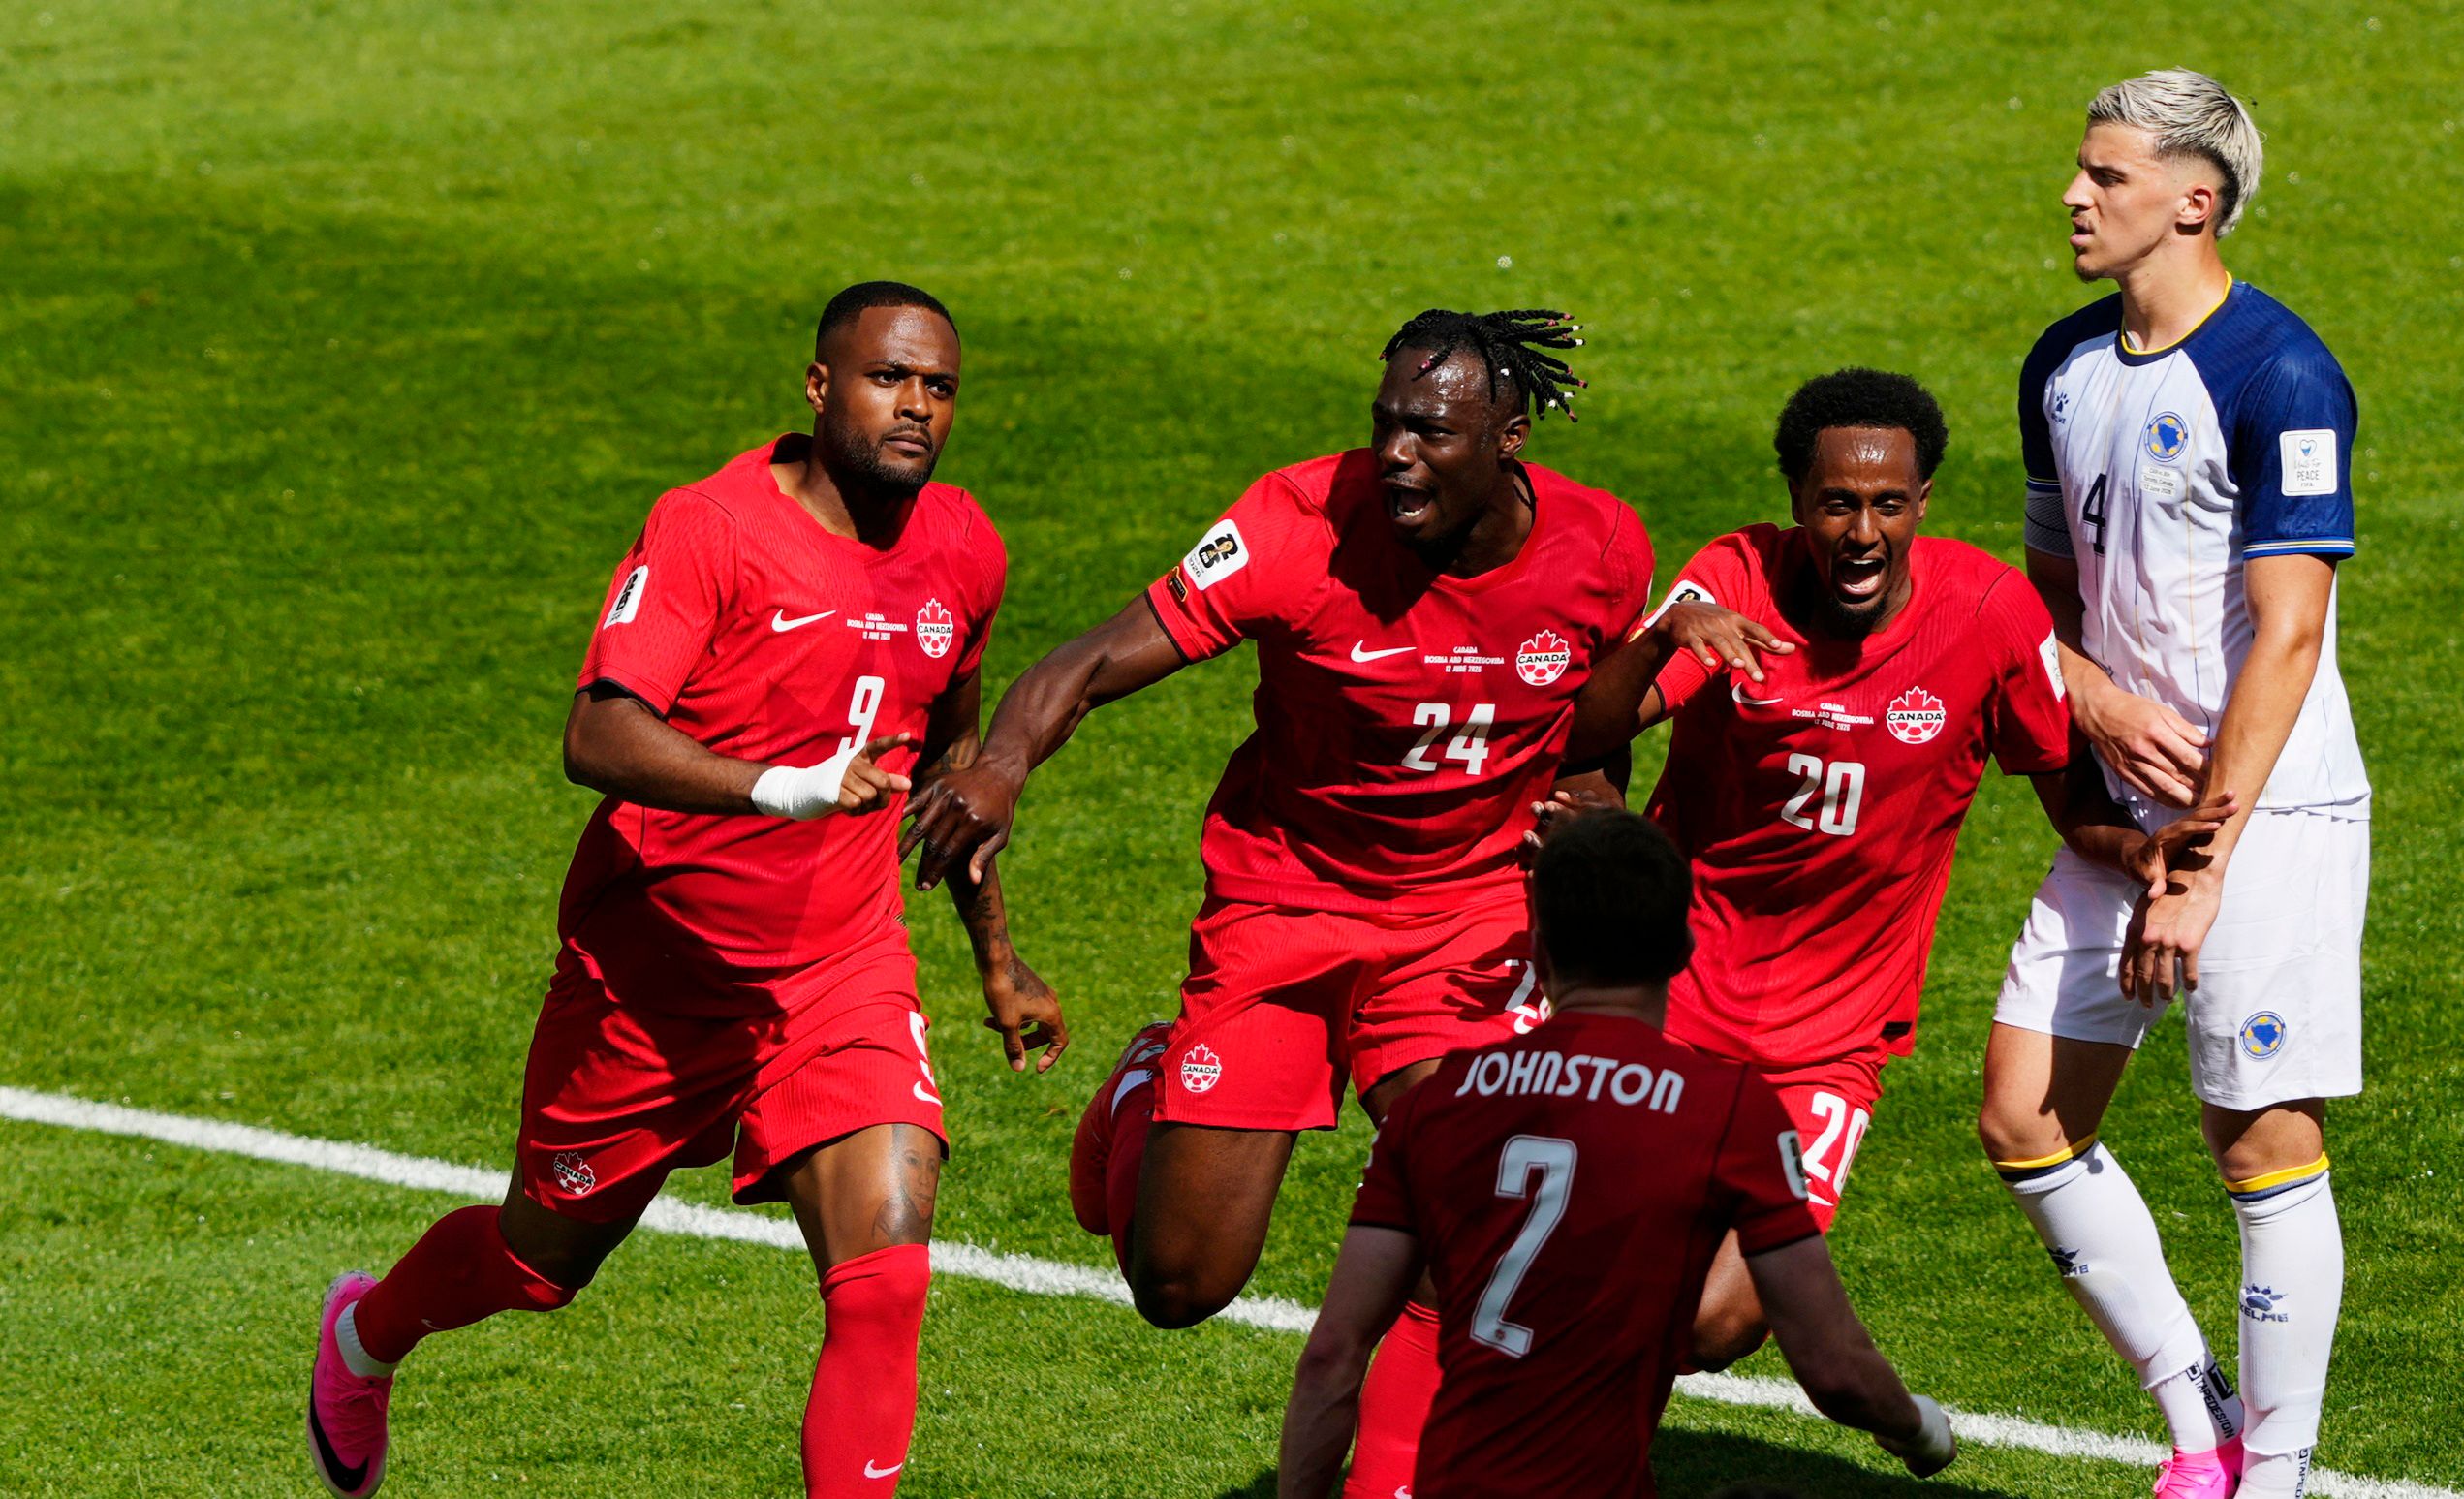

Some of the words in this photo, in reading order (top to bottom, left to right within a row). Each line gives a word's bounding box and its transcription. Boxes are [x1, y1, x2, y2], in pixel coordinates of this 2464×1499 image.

[2296, 470, 2320, 481] PEACE
[2083, 473, 2106, 557] 4
[918, 625, 951, 634] CANADA
[1424, 655, 1448, 664] BOSNIA
[1517, 654, 1567, 664] CANADA
[837, 675, 886, 755] 9
[1792, 708, 1816, 718] BOSNIA
[1887, 712, 1944, 721] CANADA
[1401, 703, 1496, 775] 24
[1780, 752, 1866, 836] 20
[1182, 1065, 1218, 1075] CANADA
[1455, 1050, 1685, 1114] JOHNSTON
[1802, 1091, 1870, 1198] 20
[554, 1161, 593, 1185] CANADA
[1470, 1134, 1578, 1358] 2
